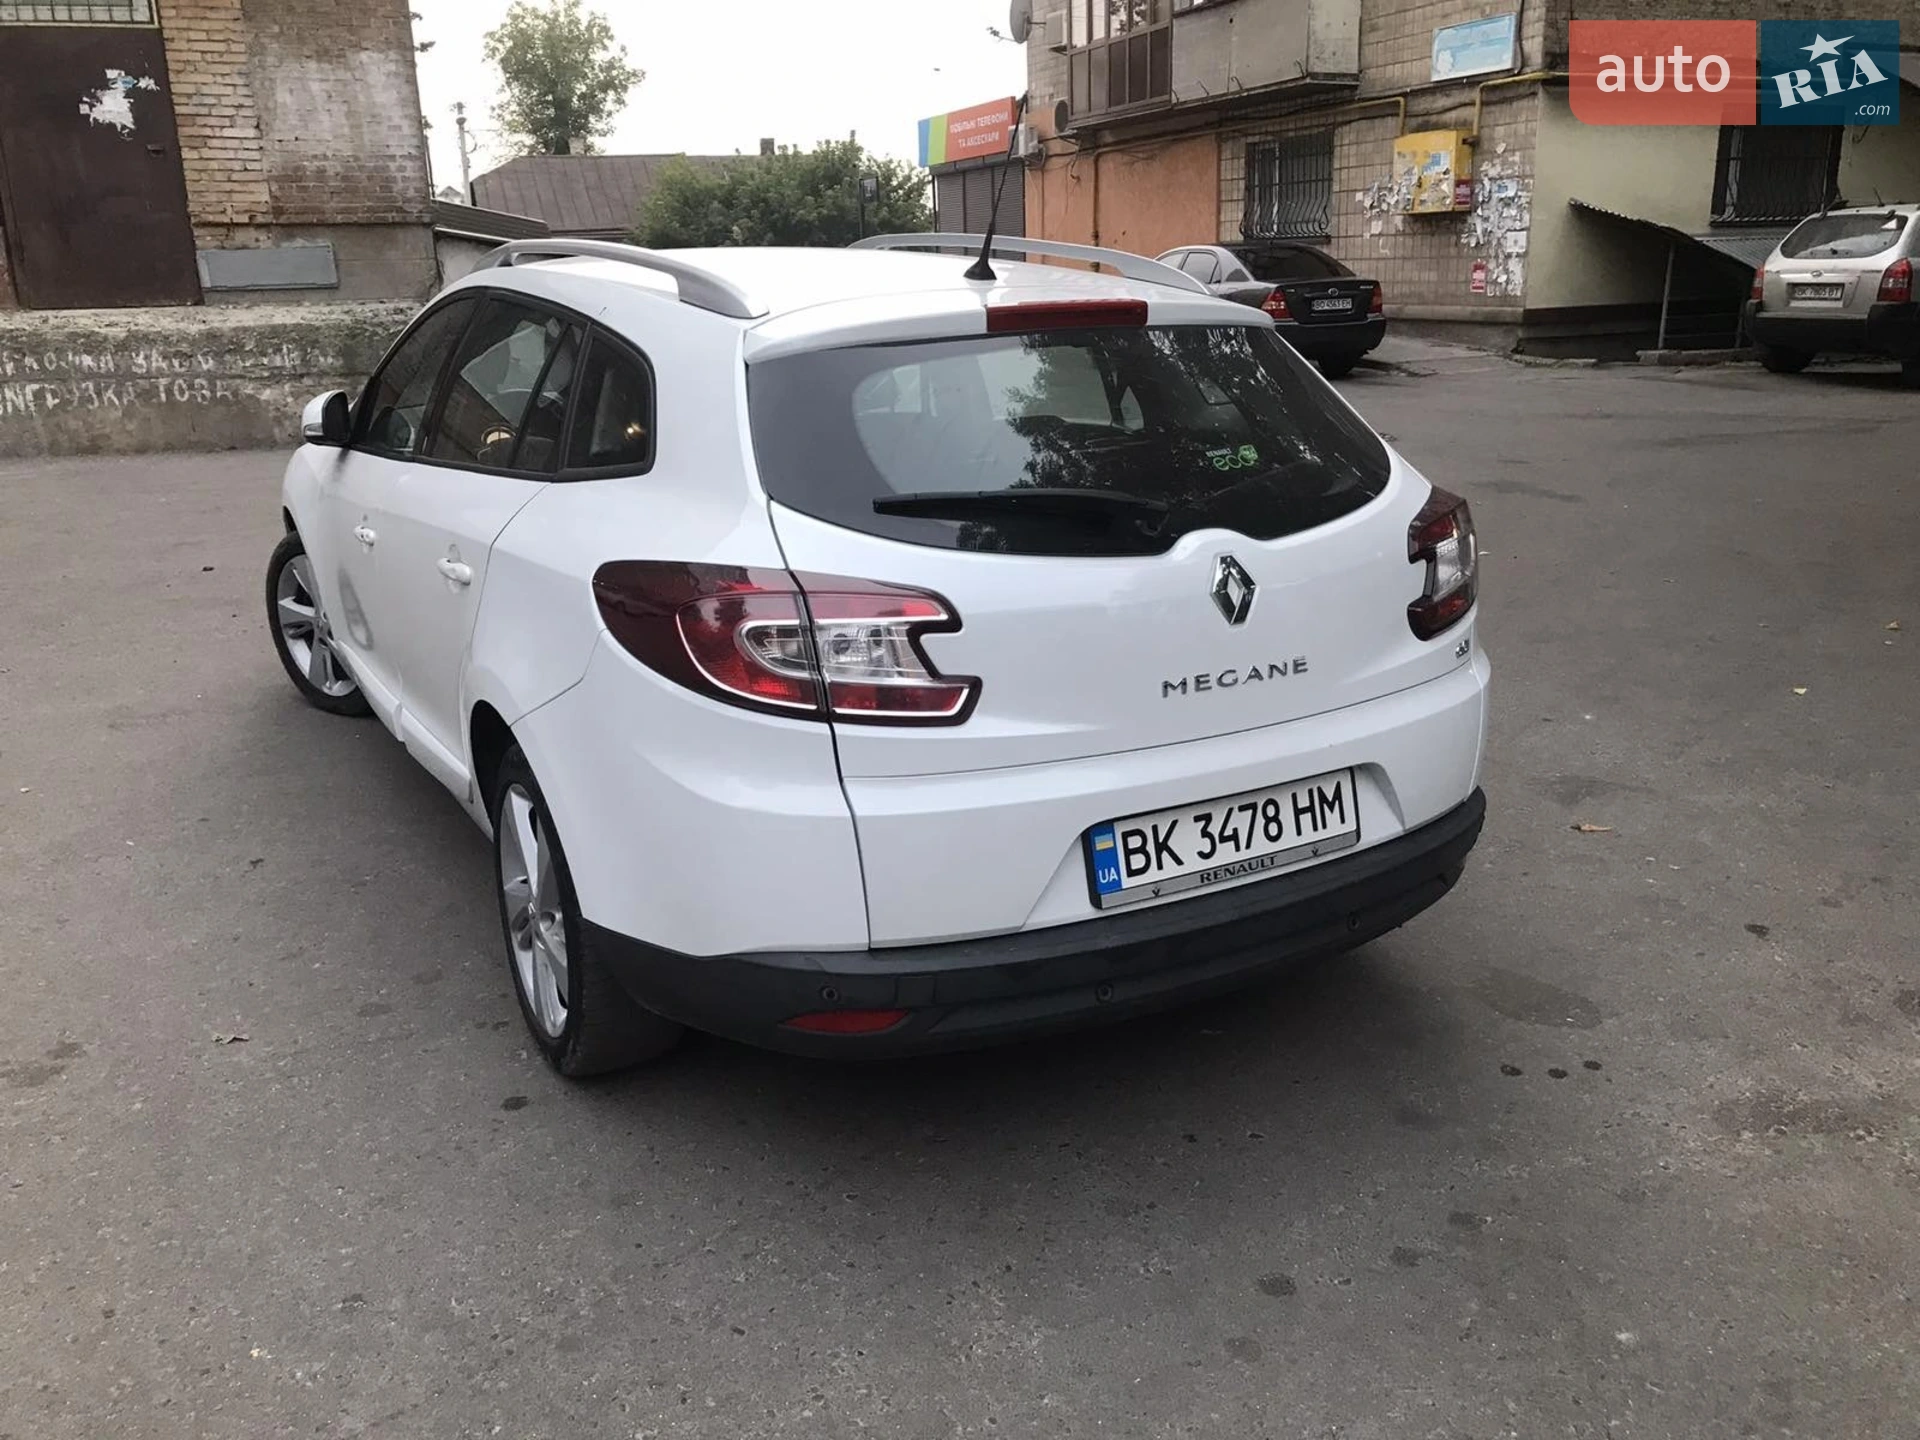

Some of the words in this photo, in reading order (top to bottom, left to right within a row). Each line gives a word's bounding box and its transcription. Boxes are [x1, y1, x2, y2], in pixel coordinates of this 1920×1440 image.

[1161, 655, 1310, 699] MEGANE
[1121, 818, 1185, 878] BK
[1192, 797, 1283, 860] 3478
[1290, 780, 1346, 837] HM
[1098, 868, 1119, 884] UA
[1199, 854, 1278, 884] RENAULT
